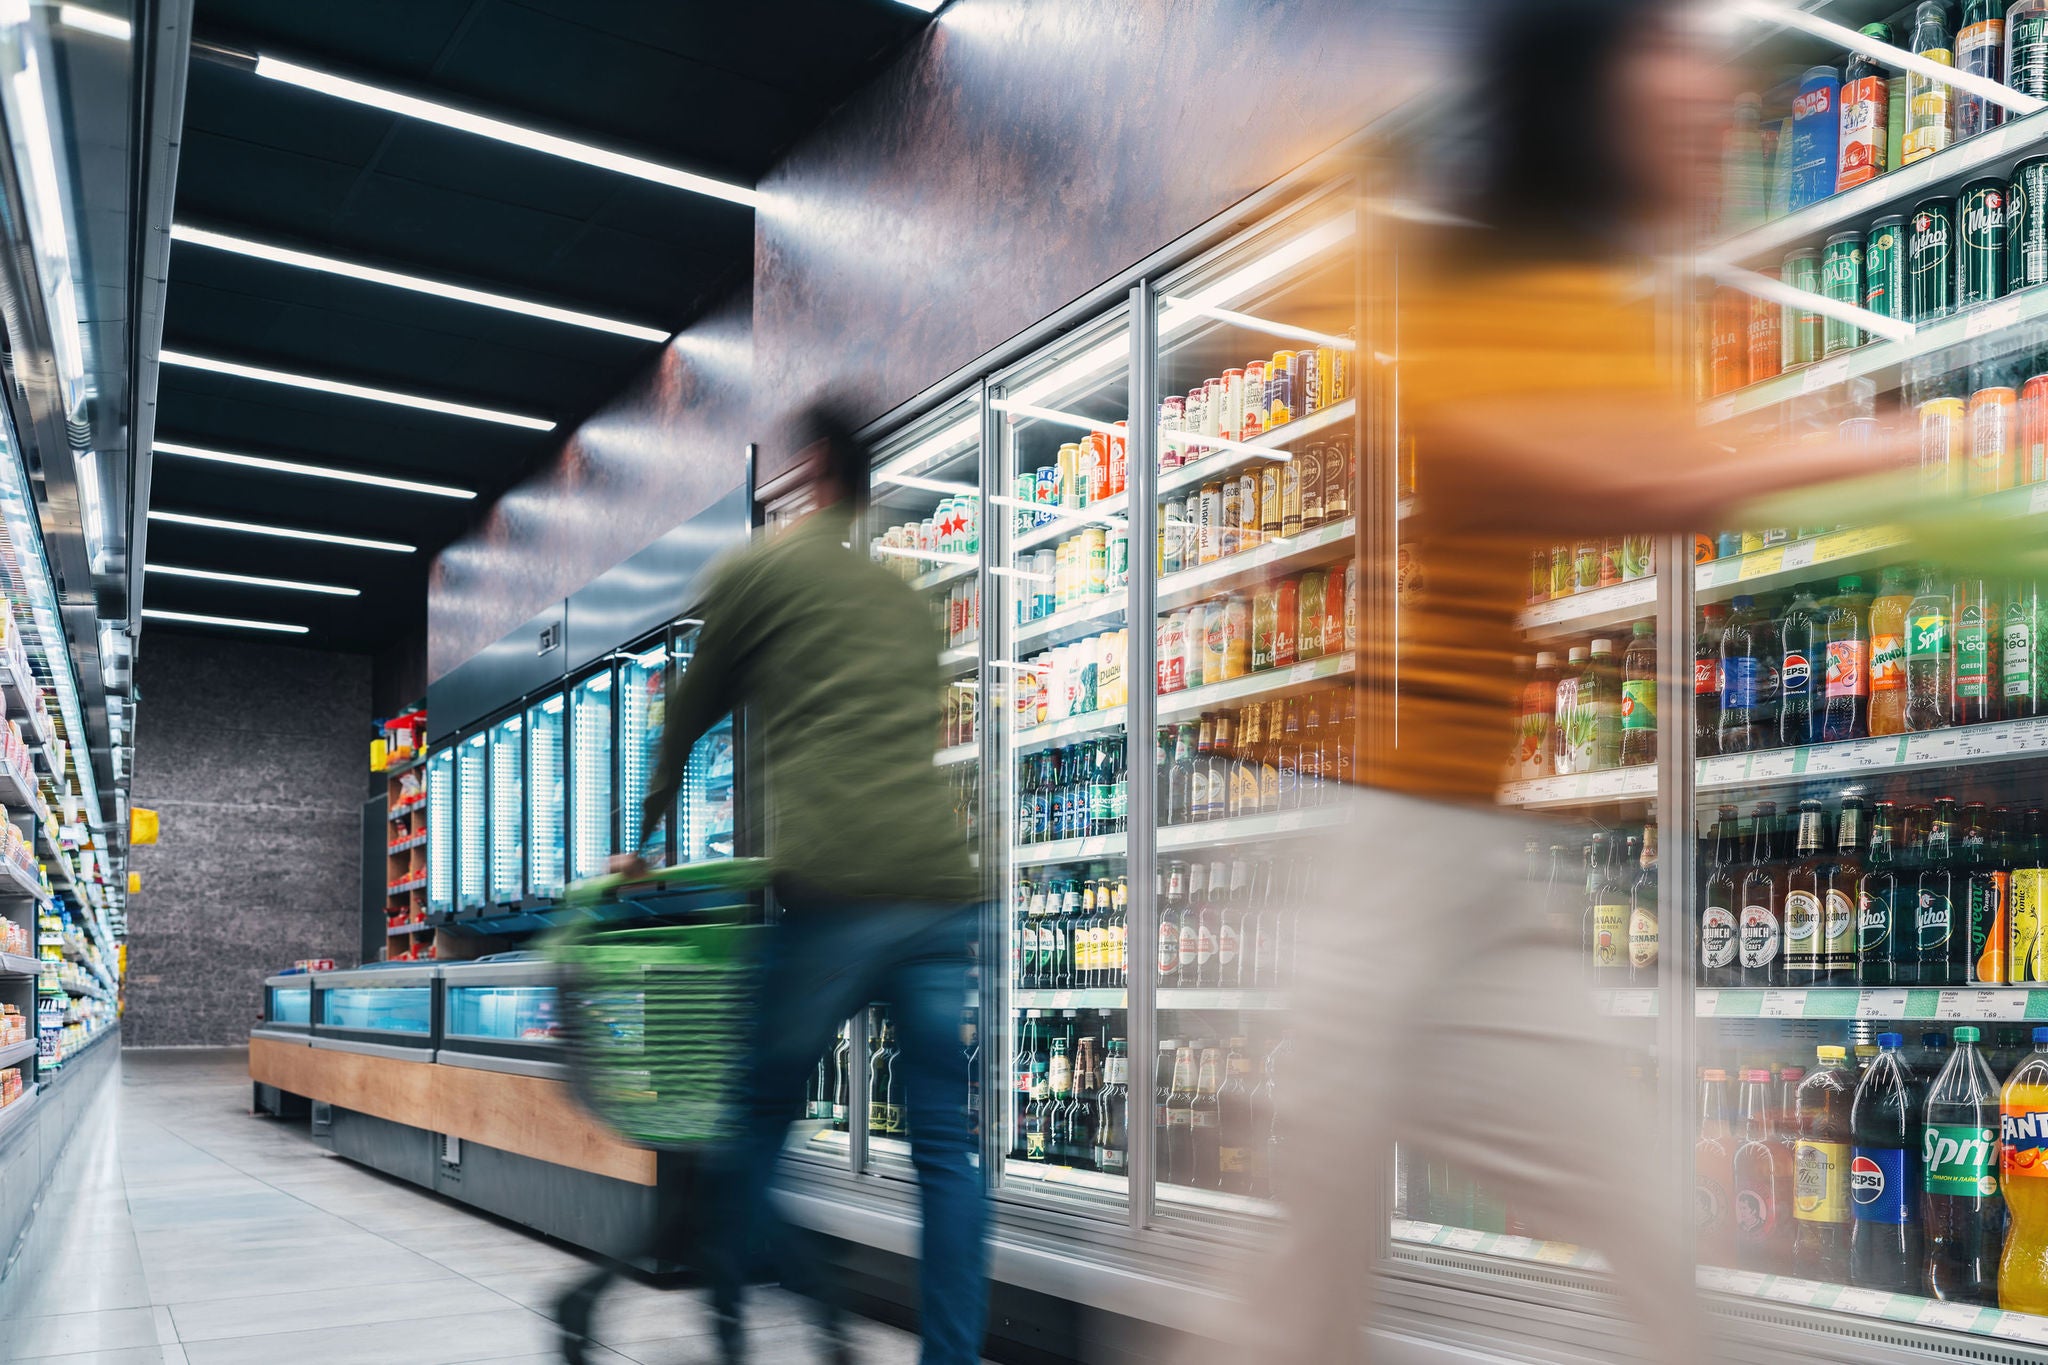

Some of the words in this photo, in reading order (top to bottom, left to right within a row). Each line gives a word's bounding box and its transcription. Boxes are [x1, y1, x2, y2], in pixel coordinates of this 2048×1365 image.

[1968, 207, 2004, 235] Myth
[1824, 260, 1852, 287] DAB
[1747, 318, 1781, 336] RELL
[1917, 622, 1949, 650] Sprit
[1967, 634, 1980, 642] ICE
[2009, 632, 2020, 640] ICE
[1958, 639, 1986, 652] tea
[2005, 638, 2027, 650] tea
[1870, 646, 1908, 669] IRIND
[1783, 667, 1808, 677] PEPSI
[1961, 662, 1983, 670] GREEN
[1983, 889, 1991, 912] Orange
[1826, 911, 1848, 921] steiner
[1972, 883, 1987, 956] green
[1629, 933, 1659, 943] ERNAR
[2001, 1112, 2048, 1141] FANT
[1922, 1128, 2001, 1171] Sprit
[1852, 1173, 1881, 1187] PEPSI
[1932, 1174, 1952, 1182] ЛИМОН
